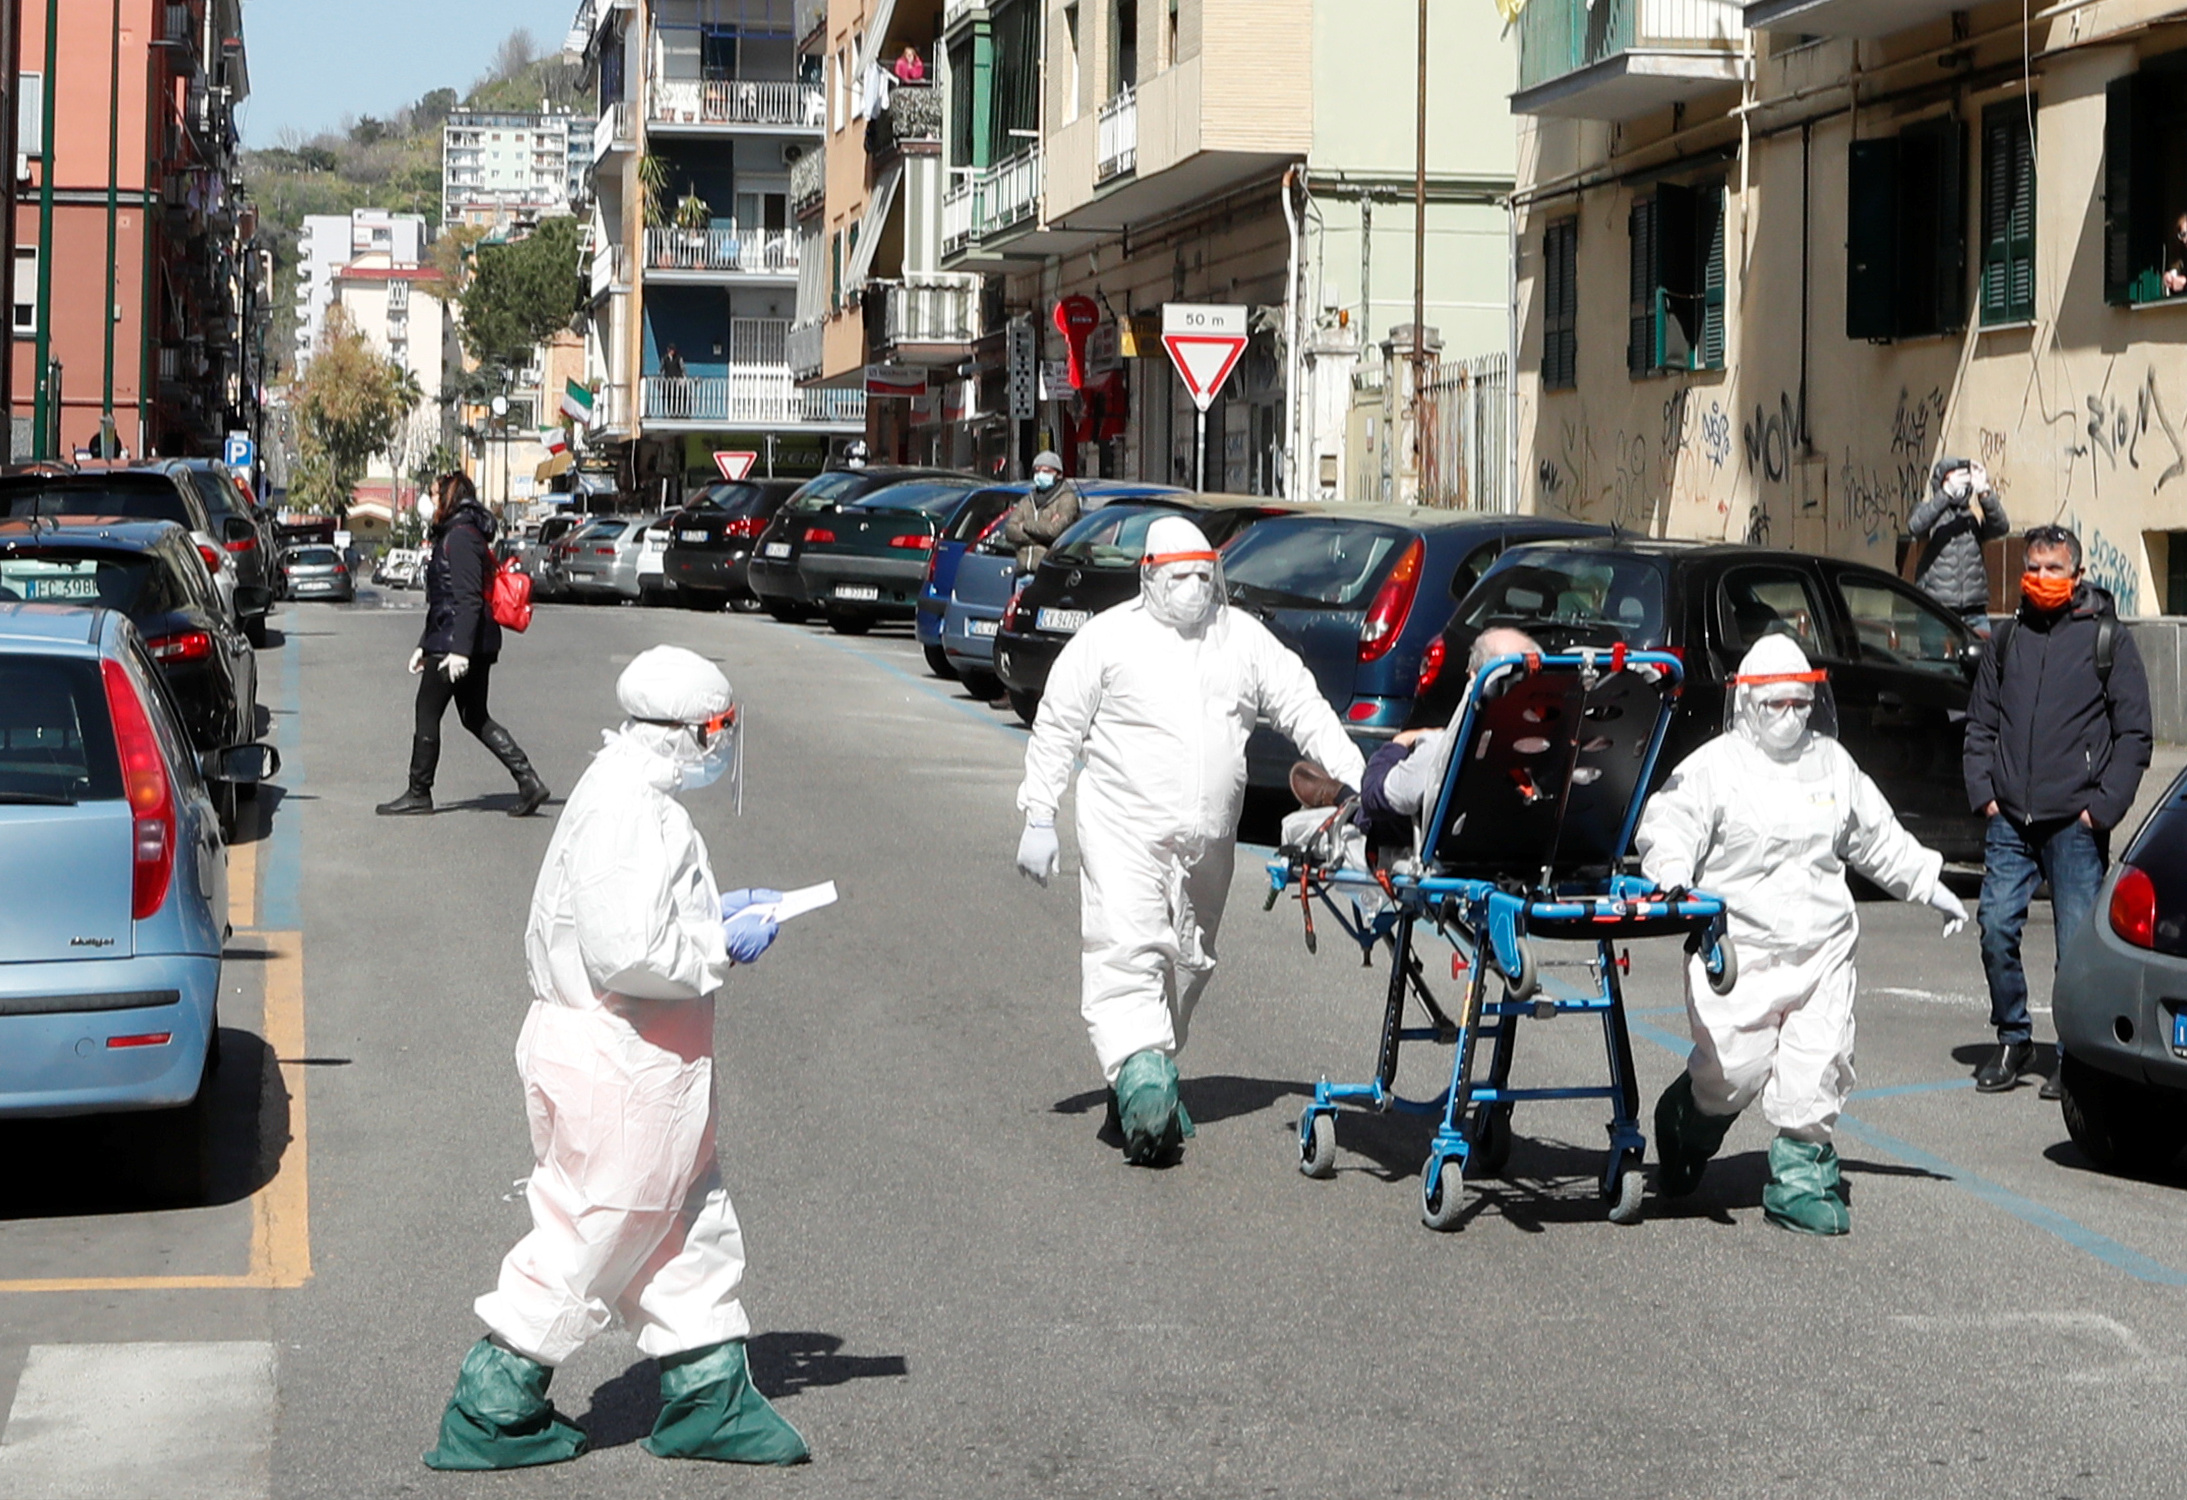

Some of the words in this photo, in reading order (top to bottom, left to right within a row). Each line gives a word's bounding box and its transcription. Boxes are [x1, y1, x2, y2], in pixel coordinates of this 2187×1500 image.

[1186, 313, 1205, 326] 50
[1212, 316, 1224, 326] m
[231, 442, 247, 463] P
